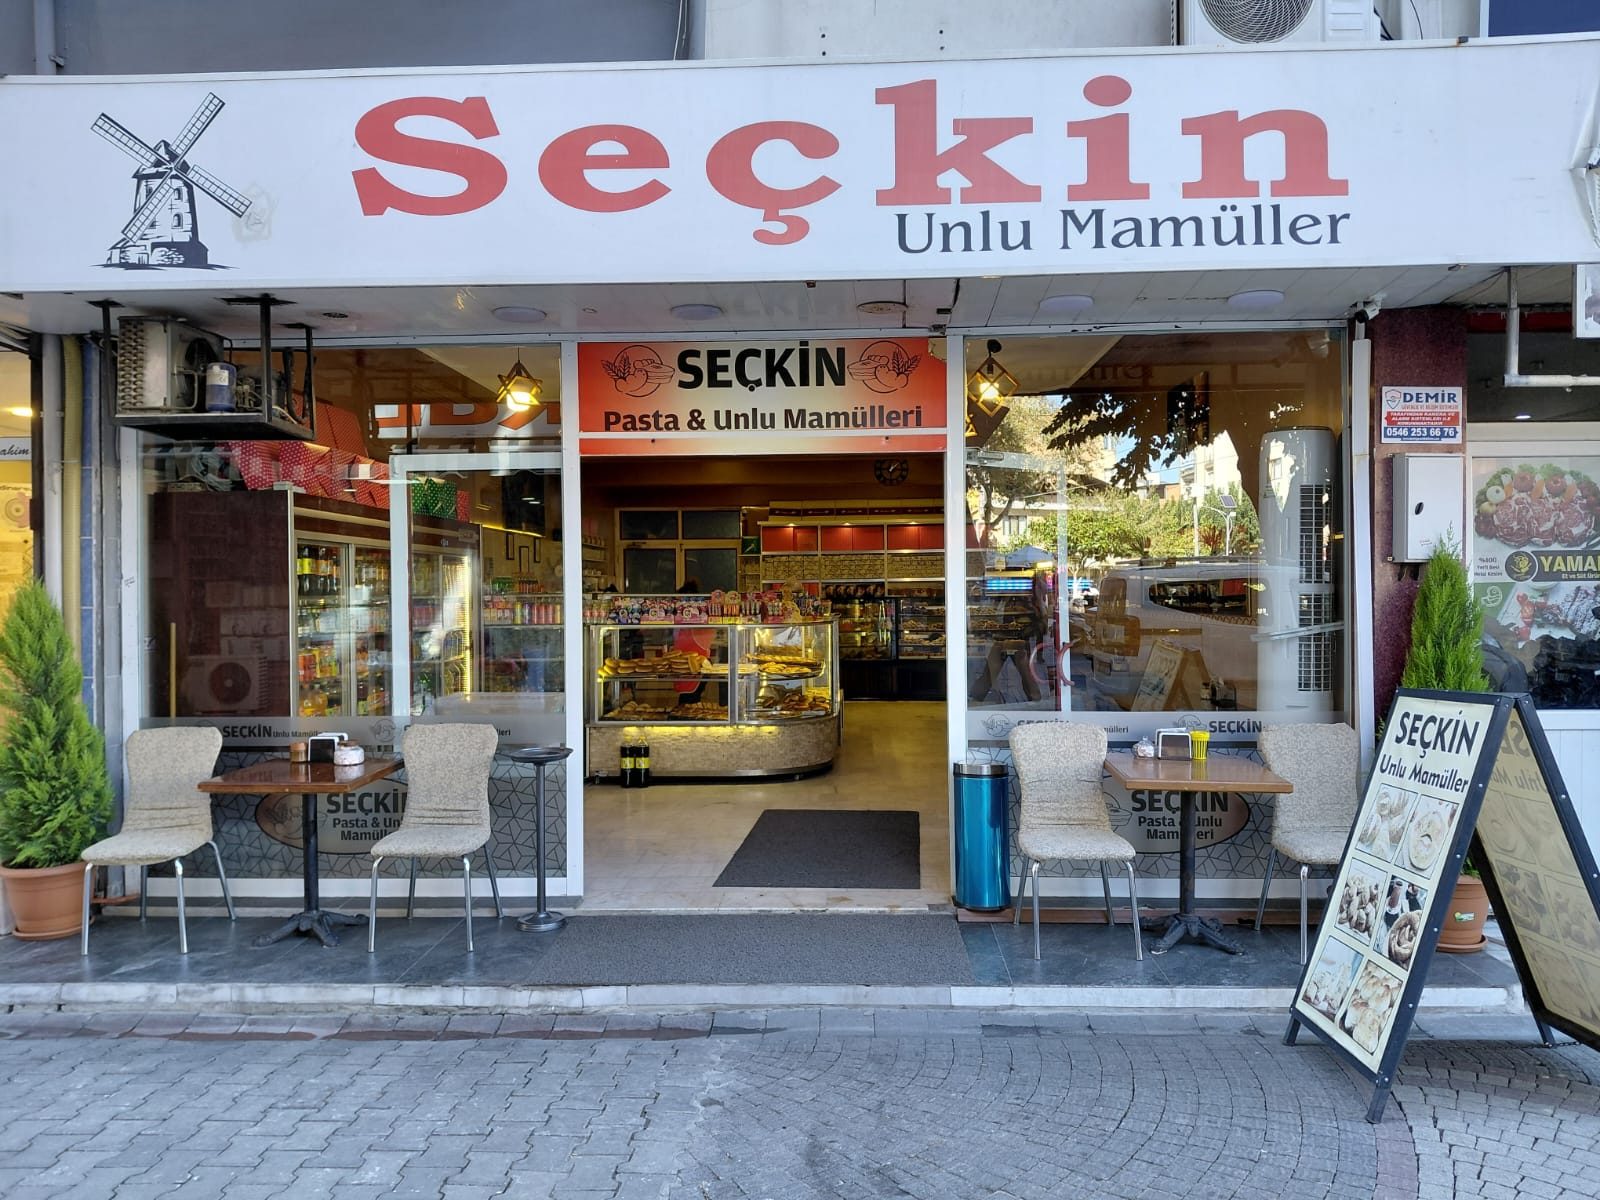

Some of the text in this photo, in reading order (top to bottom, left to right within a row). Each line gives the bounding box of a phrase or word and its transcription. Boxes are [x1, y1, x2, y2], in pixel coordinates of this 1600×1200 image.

[352, 75, 1349, 245] Seçkin
[897, 200, 1350, 253] Unlu Mamüller
[677, 341, 846, 392] SEÇKİN
[1403, 390, 1457, 403] DEMİR
[604, 405, 923, 432] Pasta & Unlu Mamülleri
[1386, 427, 1455, 436] 0546 253 66 76
[222, 724, 272, 740] SEÇKİN
[1208, 718, 1262, 734] SEÇKİN
[1395, 709, 1480, 759] SEÇKİN
[1380, 754, 1407, 778] Unlu
[1408, 762, 1469, 793] Mamüller
[332, 818, 367, 828] Pasta
[371, 817, 380, 828] &
[1138, 816, 1176, 827] Pasta
